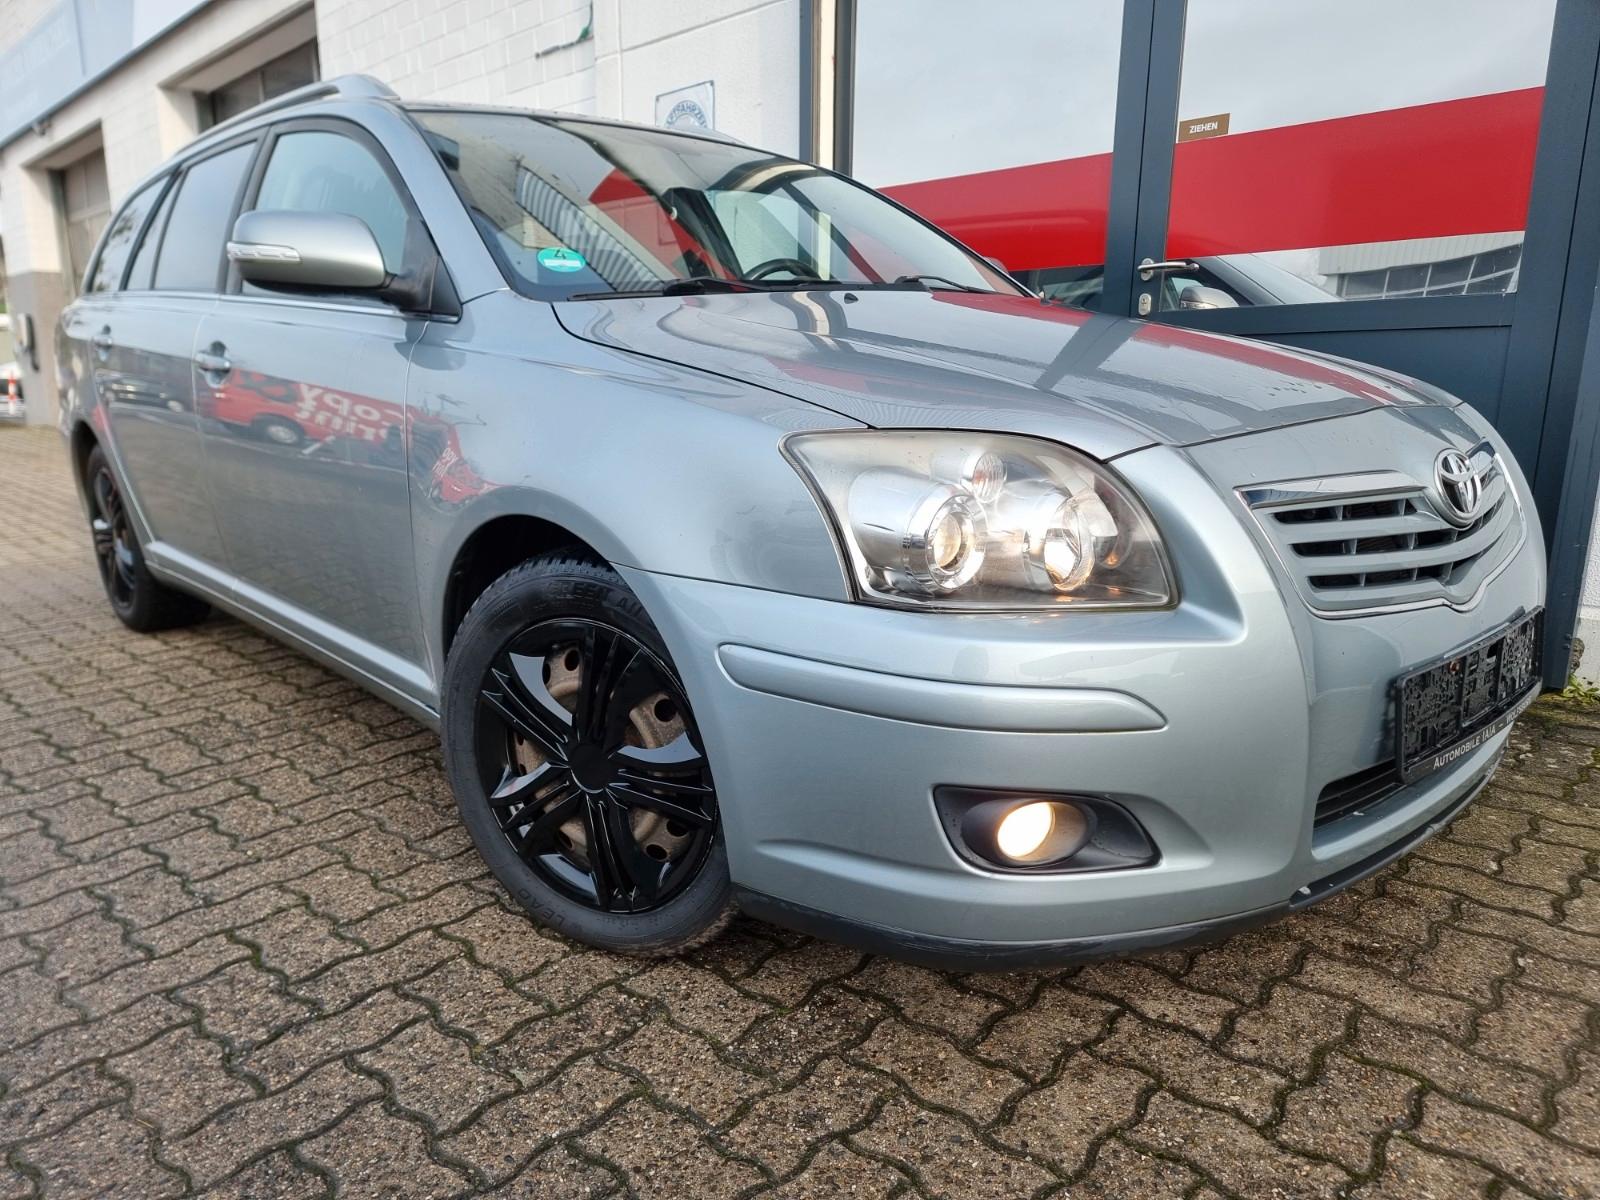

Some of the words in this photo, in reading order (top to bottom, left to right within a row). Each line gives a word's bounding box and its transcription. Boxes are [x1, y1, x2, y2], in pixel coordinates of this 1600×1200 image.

[1189, 121, 1219, 134] ZIEHEN
[554, 249, 567, 259] 4
[1433, 735, 1481, 770] AUTOMOBILE
